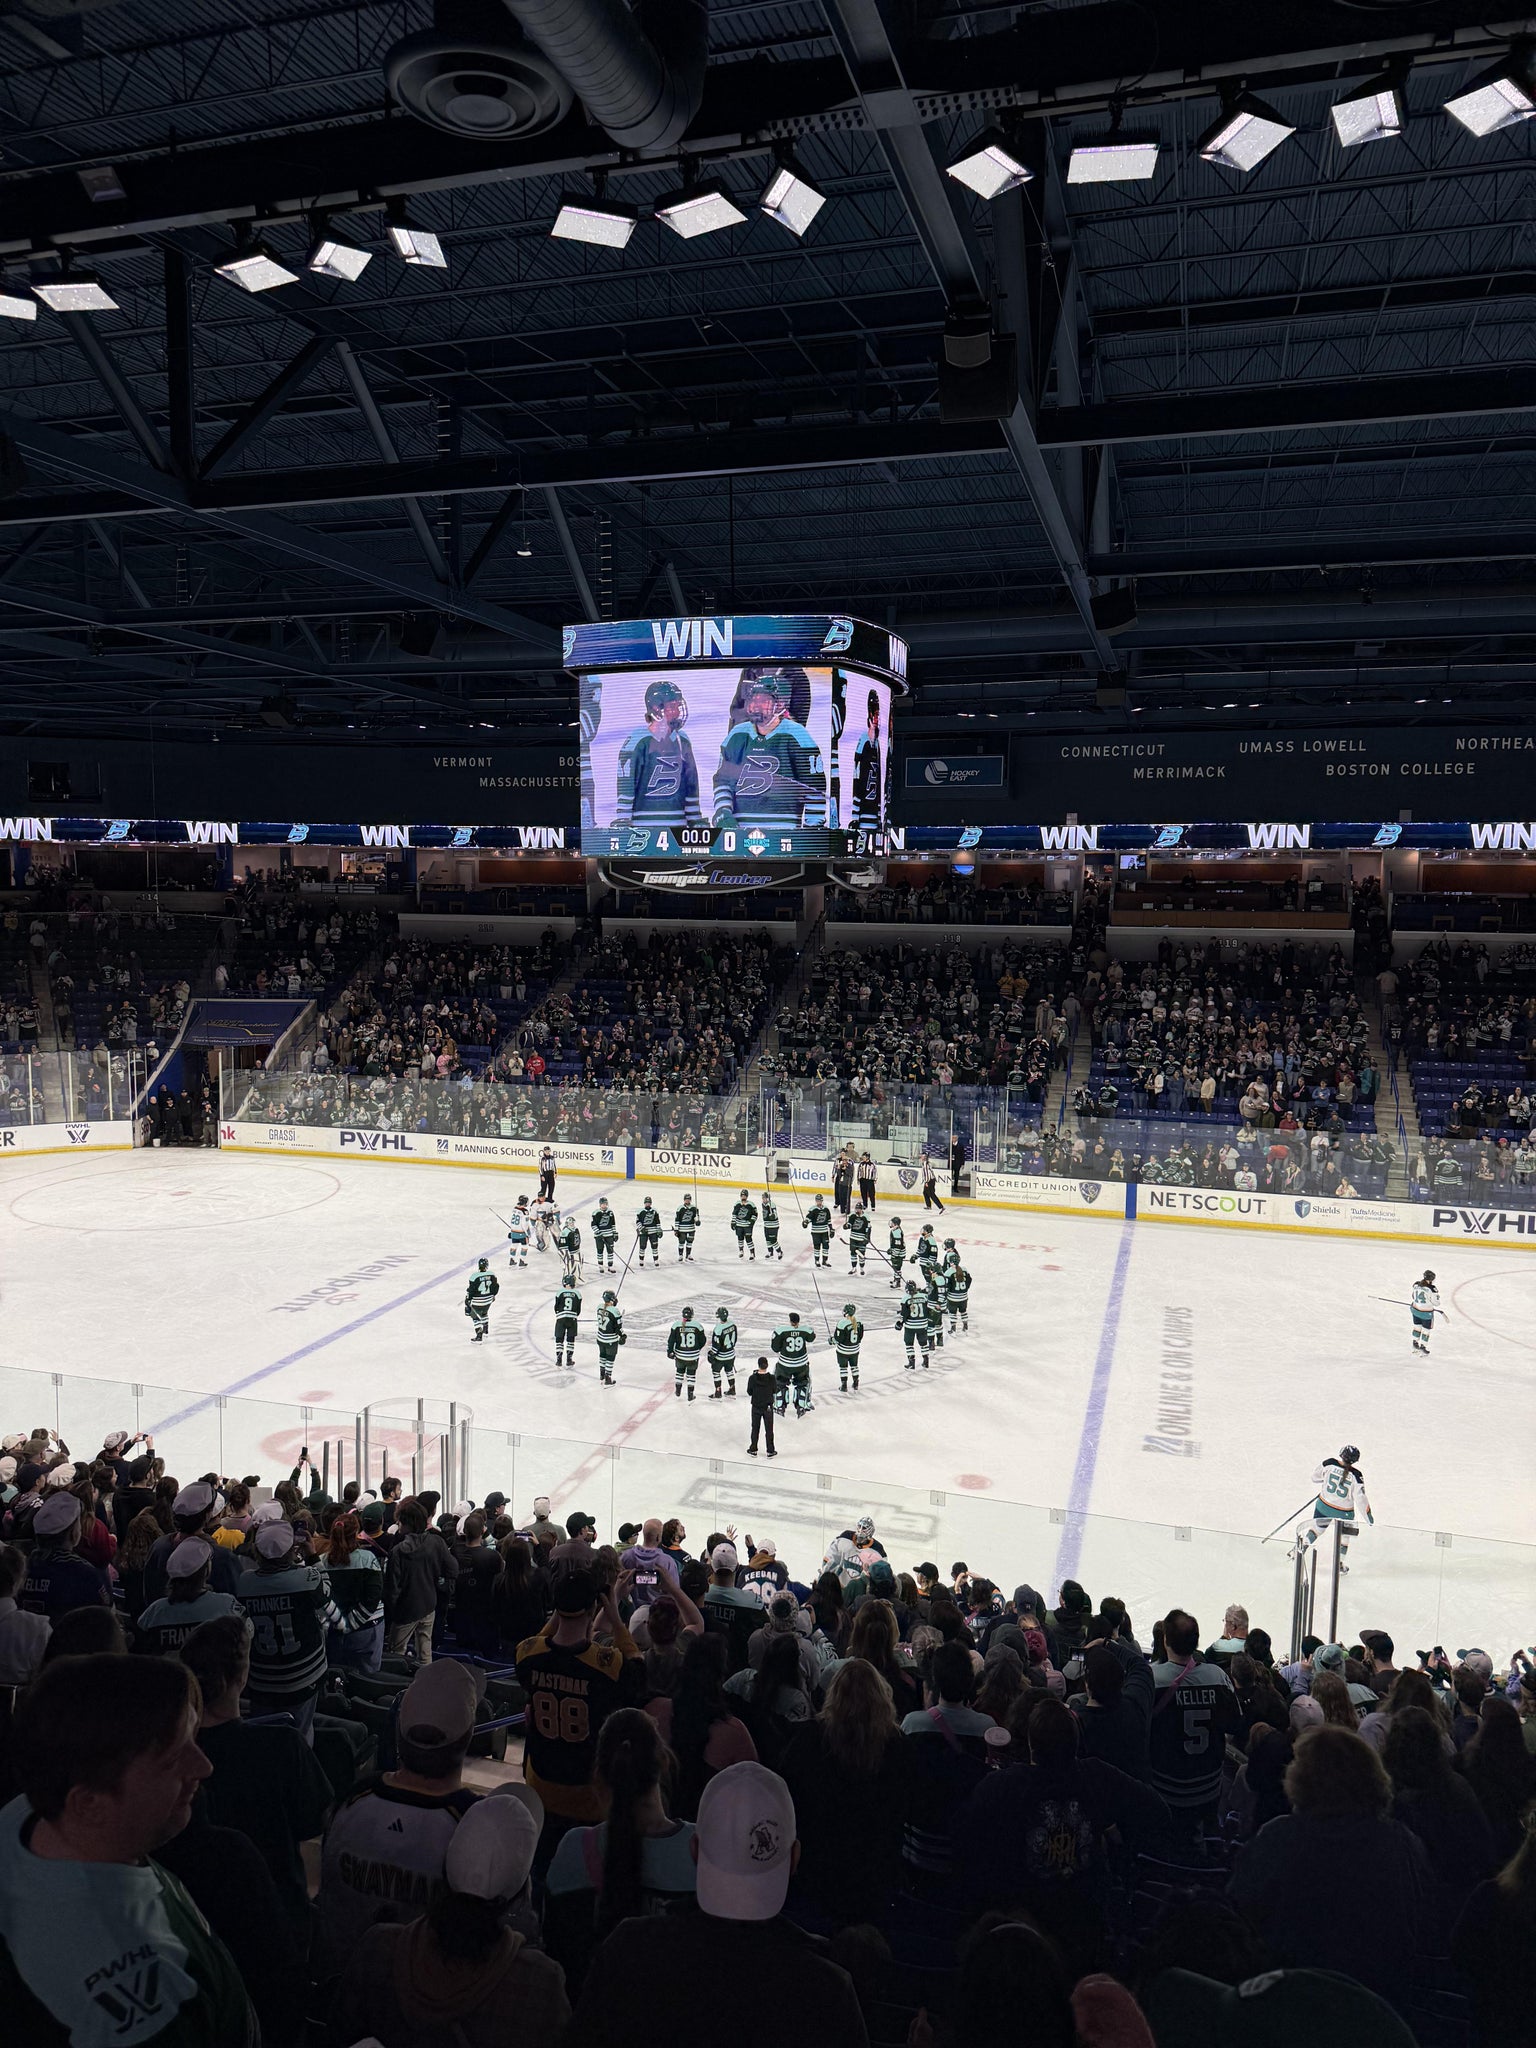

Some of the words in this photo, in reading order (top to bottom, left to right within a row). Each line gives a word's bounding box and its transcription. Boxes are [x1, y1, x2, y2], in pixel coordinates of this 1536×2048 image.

[652, 619, 733, 658] WIN
[888, 634, 907, 678] WIN
[1061, 744, 1165, 758] CONNECTICUT
[1239, 741, 1294, 753] UMASS
[1303, 740, 1367, 752] LOWELL
[1456, 738, 1536, 750] NORTHEA
[434, 757, 493, 767] VERMONT
[1326, 764, 1390, 776] BOSTON
[1400, 763, 1476, 775] COLLEGE
[1134, 766, 1226, 779] MERRIMACK
[479, 777, 580, 787] MASSACHUSETTS
[0, 818, 52, 840] WIN
[186, 822, 238, 843] WIN
[360, 825, 410, 847] WIN
[518, 827, 564, 848] WIN
[682, 829, 711, 843] 00.0
[1040, 826, 1098, 850] WIN
[1248, 824, 1310, 848] WIN
[1470, 823, 1536, 849] WIN
[610, 841, 620, 850] 24
[656, 831, 669, 851] 4
[724, 831, 736, 851] 0
[781, 843, 791, 851] 30
[643, 872, 708, 888] Tsongas
[709, 870, 772, 885] Center
[268, 1128, 296, 1141] GRASSI
[340, 1131, 413, 1151] PWHL
[455, 1144, 498, 1155] MANNING
[500, 1147, 536, 1158] SCHOOL
[553, 1150, 595, 1161] BUSINESS
[650, 1150, 732, 1168] LOVERING
[650, 1165, 675, 1175] VOLVO
[677, 1167, 697, 1176] CARS
[699, 1168, 732, 1178] NASHUA
[788, 1168, 827, 1182] Midea
[998, 1180, 1039, 1189] CREDIT
[1042, 1182, 1077, 1191] UNION
[1151, 1191, 1266, 1215] NETSCOUT
[1312, 1205, 1341, 1215] Shields
[511, 1213, 520, 1226] 28
[267, 1255, 420, 1313] Wellpoint
[478, 1280, 493, 1294] 47
[563, 1297, 573, 1310] 9
[1415, 1290, 1427, 1304] 14
[1162, 1306, 1194, 1348] CAMPUS
[680, 1332, 696, 1347] 18
[786, 1336, 804, 1353] 39
[1161, 1350, 1194, 1369] ON
[1155, 1383, 1194, 1436] ONLINE
[1327, 1473, 1351, 1498] 55
[25, 1577, 50, 1593] ELLER
[246, 1596, 294, 1614] FRANKEL
[531, 1669, 590, 1696] PASTRNAK
[1175, 1689, 1217, 1707] KELLER
[532, 1690, 591, 1743] 88
[1183, 1709, 1211, 1756] 5
[83, 1942, 158, 1993] PWHL
